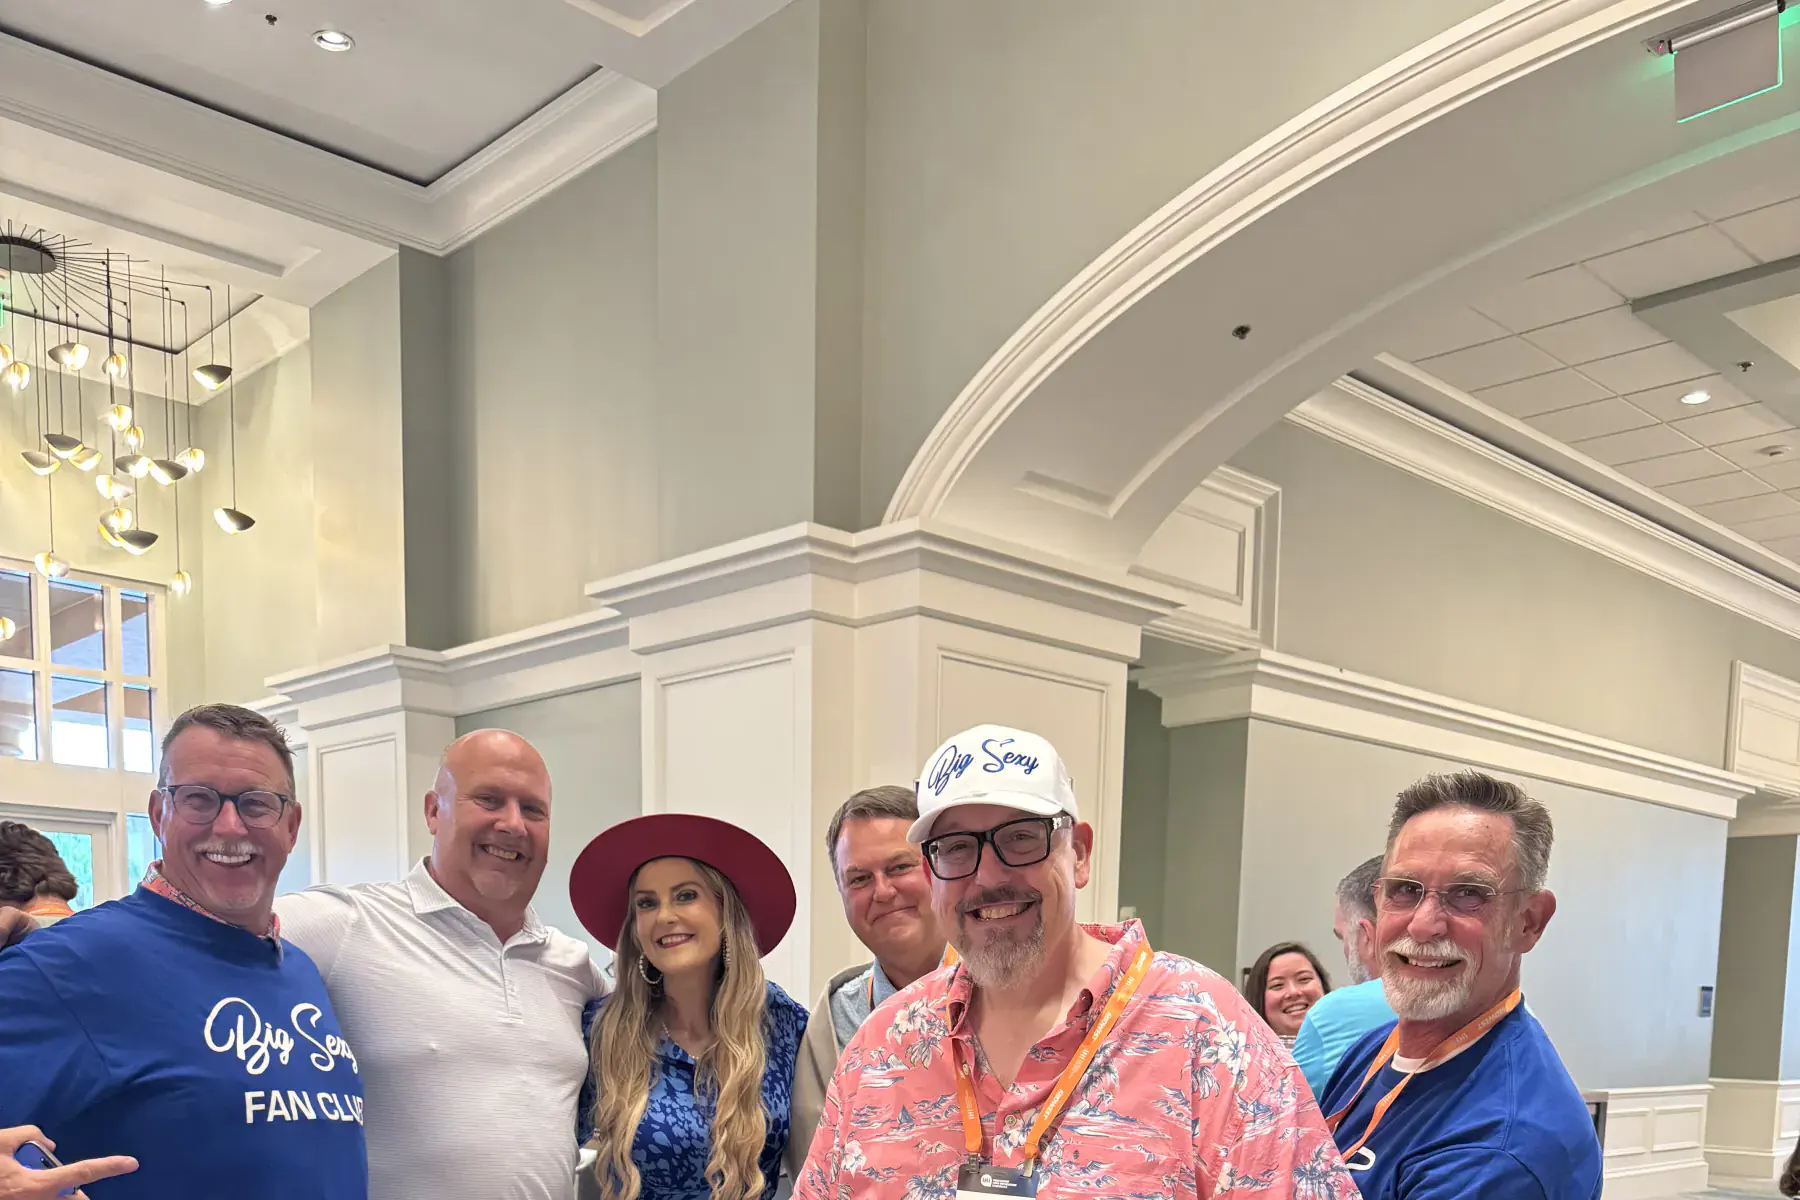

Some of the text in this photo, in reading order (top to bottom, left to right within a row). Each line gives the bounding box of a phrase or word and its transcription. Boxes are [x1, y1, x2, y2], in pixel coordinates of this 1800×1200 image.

[928, 738, 1039, 796] Big Sexy
[203, 997, 359, 1075] Big Sexy
[1091, 1011, 1112, 1041] MIDWEST
[244, 1090, 364, 1127] FAN CLUB
[1043, 1088, 1064, 1121] MIDWEST
